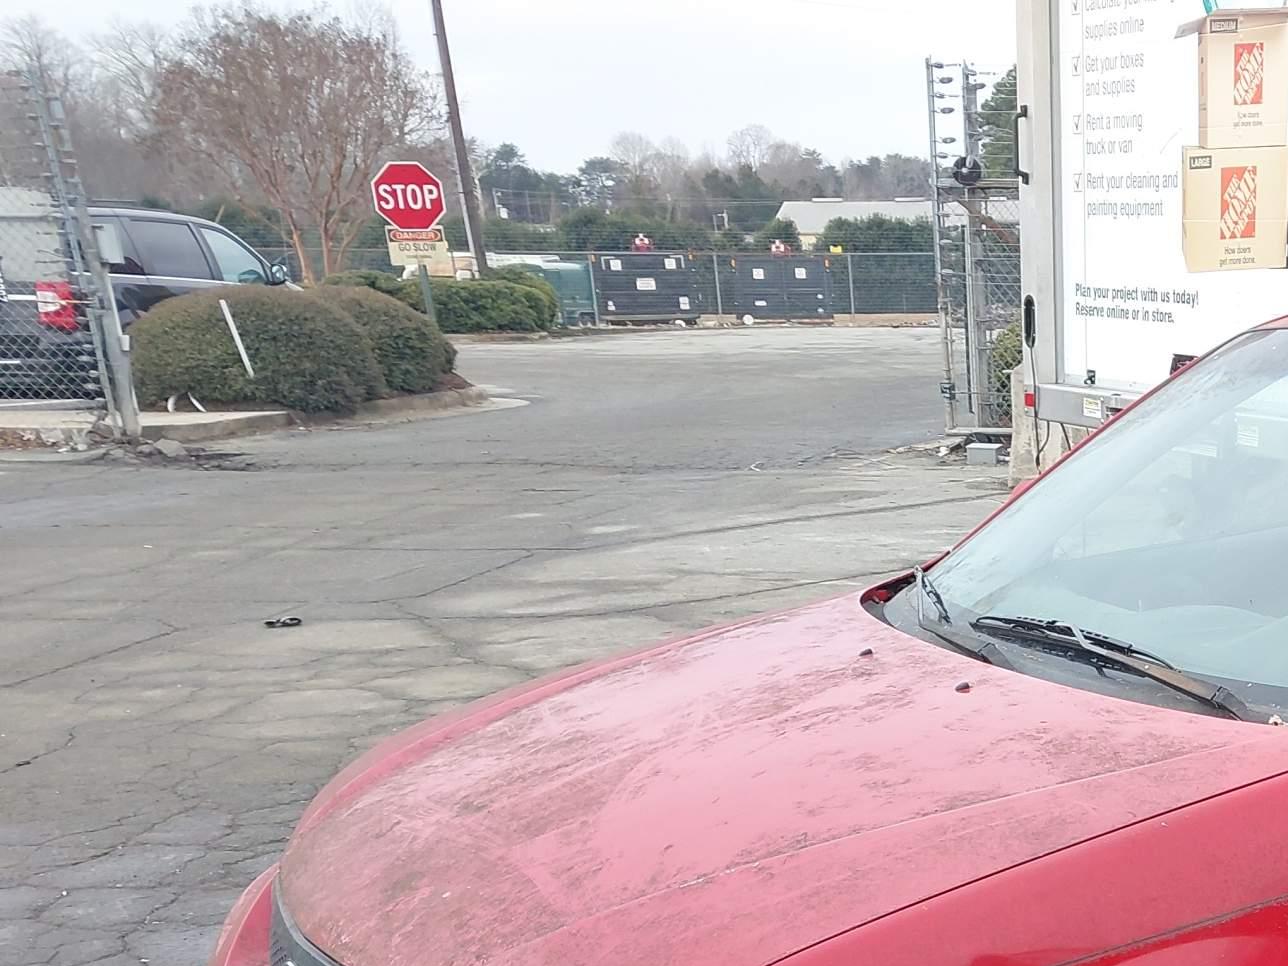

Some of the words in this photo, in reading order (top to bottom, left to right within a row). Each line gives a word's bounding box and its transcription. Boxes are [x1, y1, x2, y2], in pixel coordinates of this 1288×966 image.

[1084, 20, 1118, 40] supplies
[1120, 16, 1145, 35] online
[1085, 55, 1099, 73] Get
[1101, 56, 1118, 75] your
[1120, 52, 1145, 69] boxes
[1085, 79, 1100, 97] and
[1102, 77, 1136, 98] supplies
[1086, 113, 1105, 131] Rent
[1106, 115, 1111, 130] a
[1113, 113, 1143, 132] moving
[1086, 138, 1106, 155] truck
[1108, 140, 1116, 154] or
[1118, 139, 1133, 154] van
[1086, 172, 1105, 189] Rent
[1106, 174, 1124, 192] your
[1125, 171, 1160, 192] cleaning
[1162, 171, 1179, 188] and
[378, 184, 439, 210] STOP
[1087, 199, 1118, 219] painting
[1120, 199, 1163, 219] equipment
[396, 231, 435, 240] DANGER
[398, 243, 412, 252] GO
[414, 243, 437, 252] SLOW
[1075, 283, 1091, 298] Plan
[1093, 287, 1109, 301] your
[1112, 286, 1139, 303] project
[1140, 287, 1158, 302] with
[1160, 291, 1171, 303] us
[1173, 289, 1199, 308] today!
[1075, 302, 1105, 318] Reserve
[1107, 305, 1130, 320] online
[1131, 309, 1140, 321] or
[1142, 307, 1150, 322] in
[1152, 308, 1175, 323] store.
